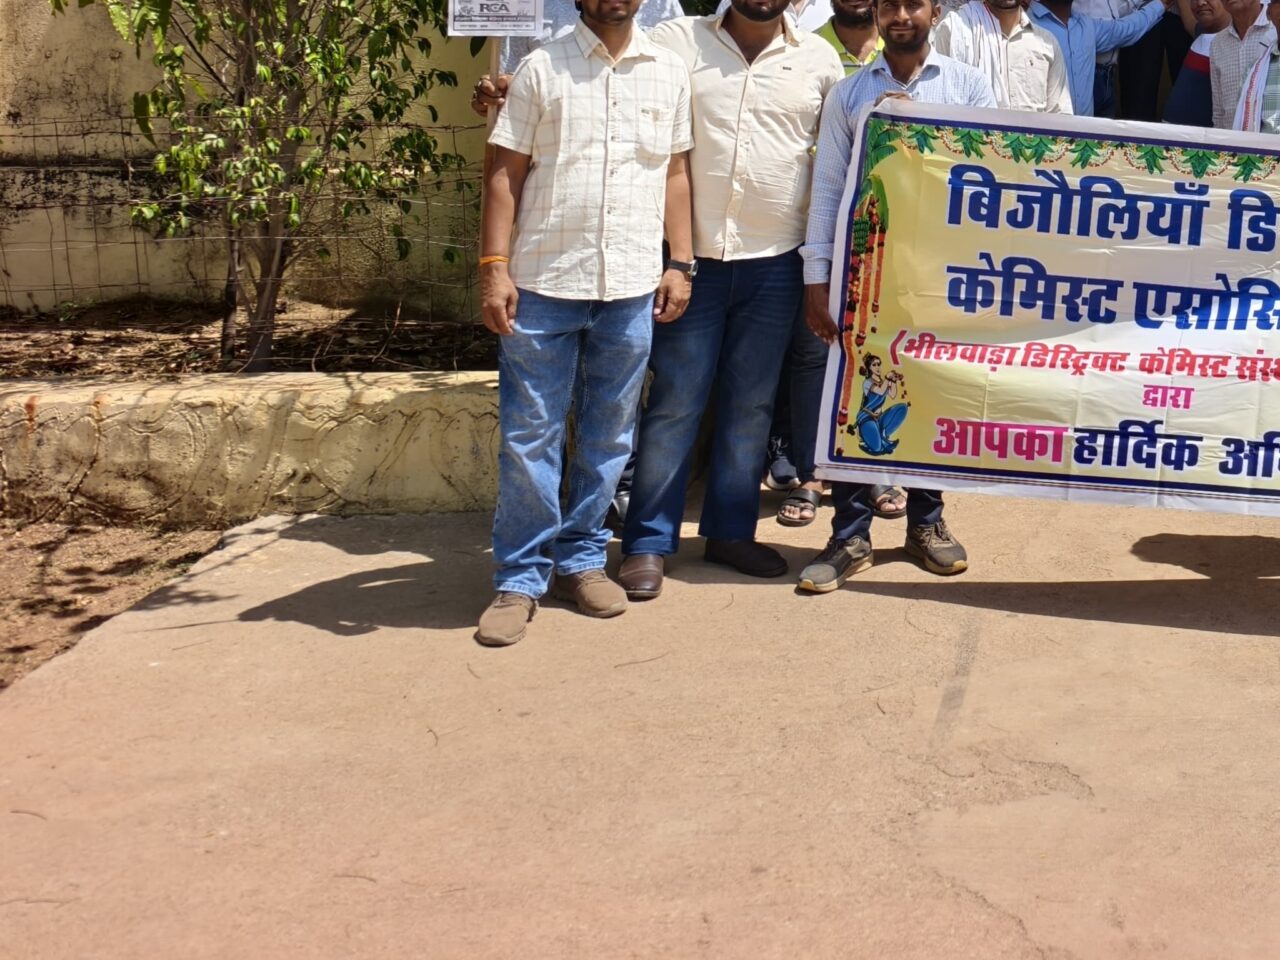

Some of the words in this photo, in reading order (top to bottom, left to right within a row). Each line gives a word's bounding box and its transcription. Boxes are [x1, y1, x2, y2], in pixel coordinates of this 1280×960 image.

[946, 163, 1210, 246] बिजौलियाँ
[946, 252, 1124, 324] केमिस्ट
[1020, 341, 1130, 376] डिस्ट्रिक्ट
[1139, 347, 1231, 378] केमिस्ट
[1142, 384, 1195, 409] द्वारा
[933, 417, 1068, 462] आपका
[1074, 419, 1203, 471] हार्दिक
